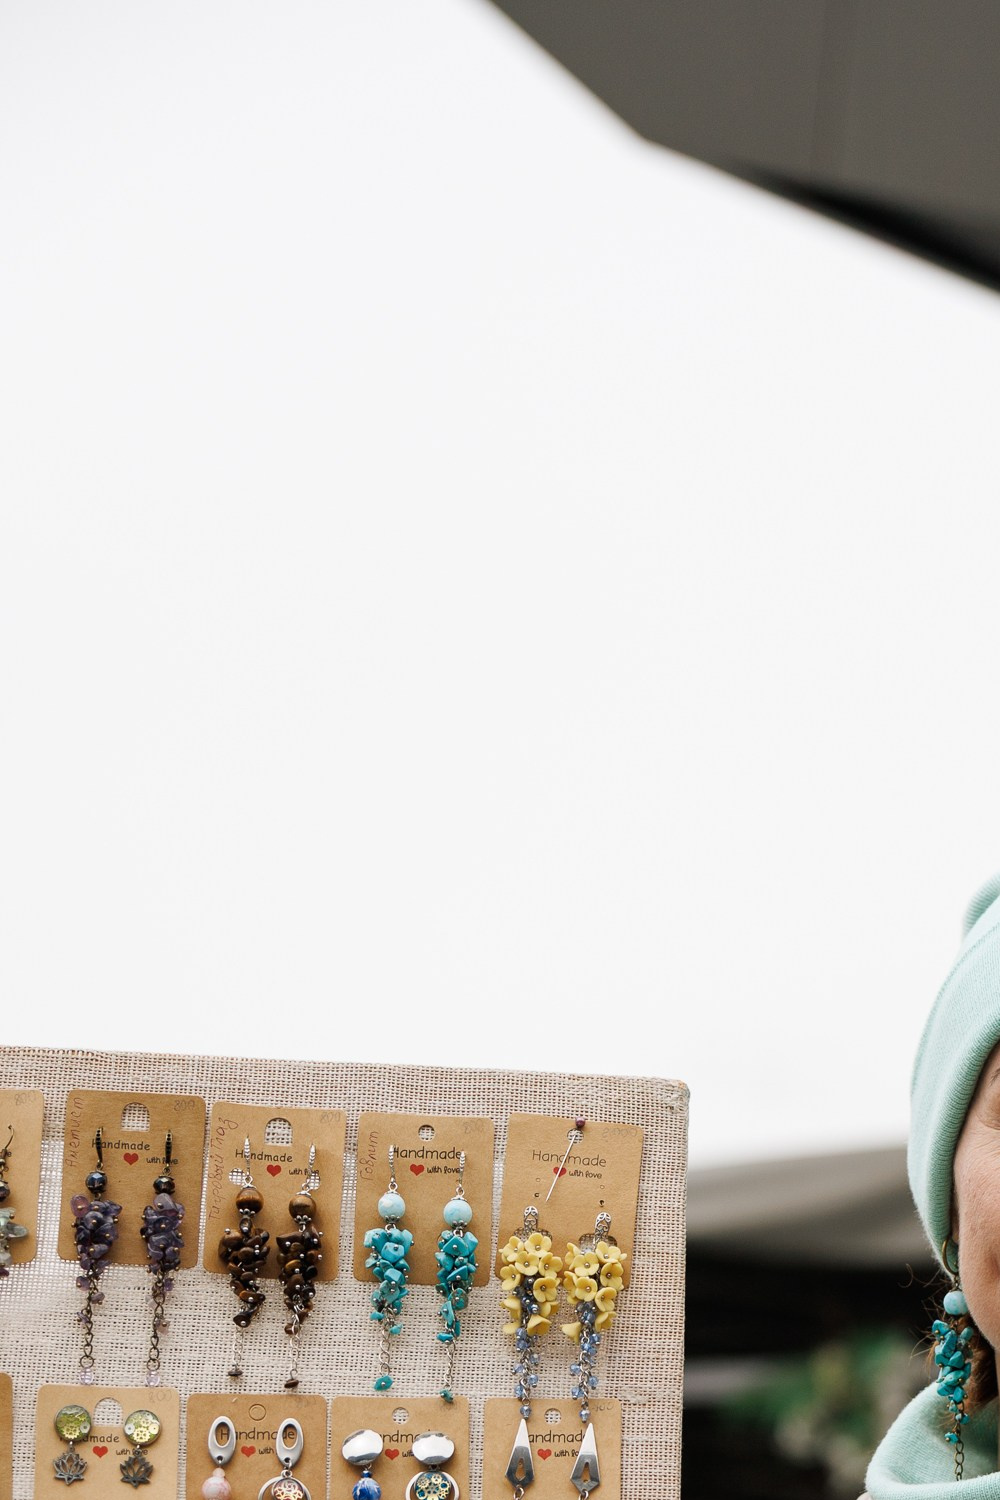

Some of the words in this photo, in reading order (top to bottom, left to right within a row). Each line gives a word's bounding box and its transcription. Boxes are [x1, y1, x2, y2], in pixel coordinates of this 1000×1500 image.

[235, 1149, 293, 1163] Hndmade
[393, 1146, 462, 1160] Handmade
[532, 1150, 607, 1168] Handmade
[427, 1165, 442, 1174] with
[568, 1170, 583, 1179] with
[585, 1170, 603, 1179] love
[220, 1427, 295, 1441] Hndmade
[528, 1430, 585, 1443] andmad
[554, 1450, 570, 1458] with
